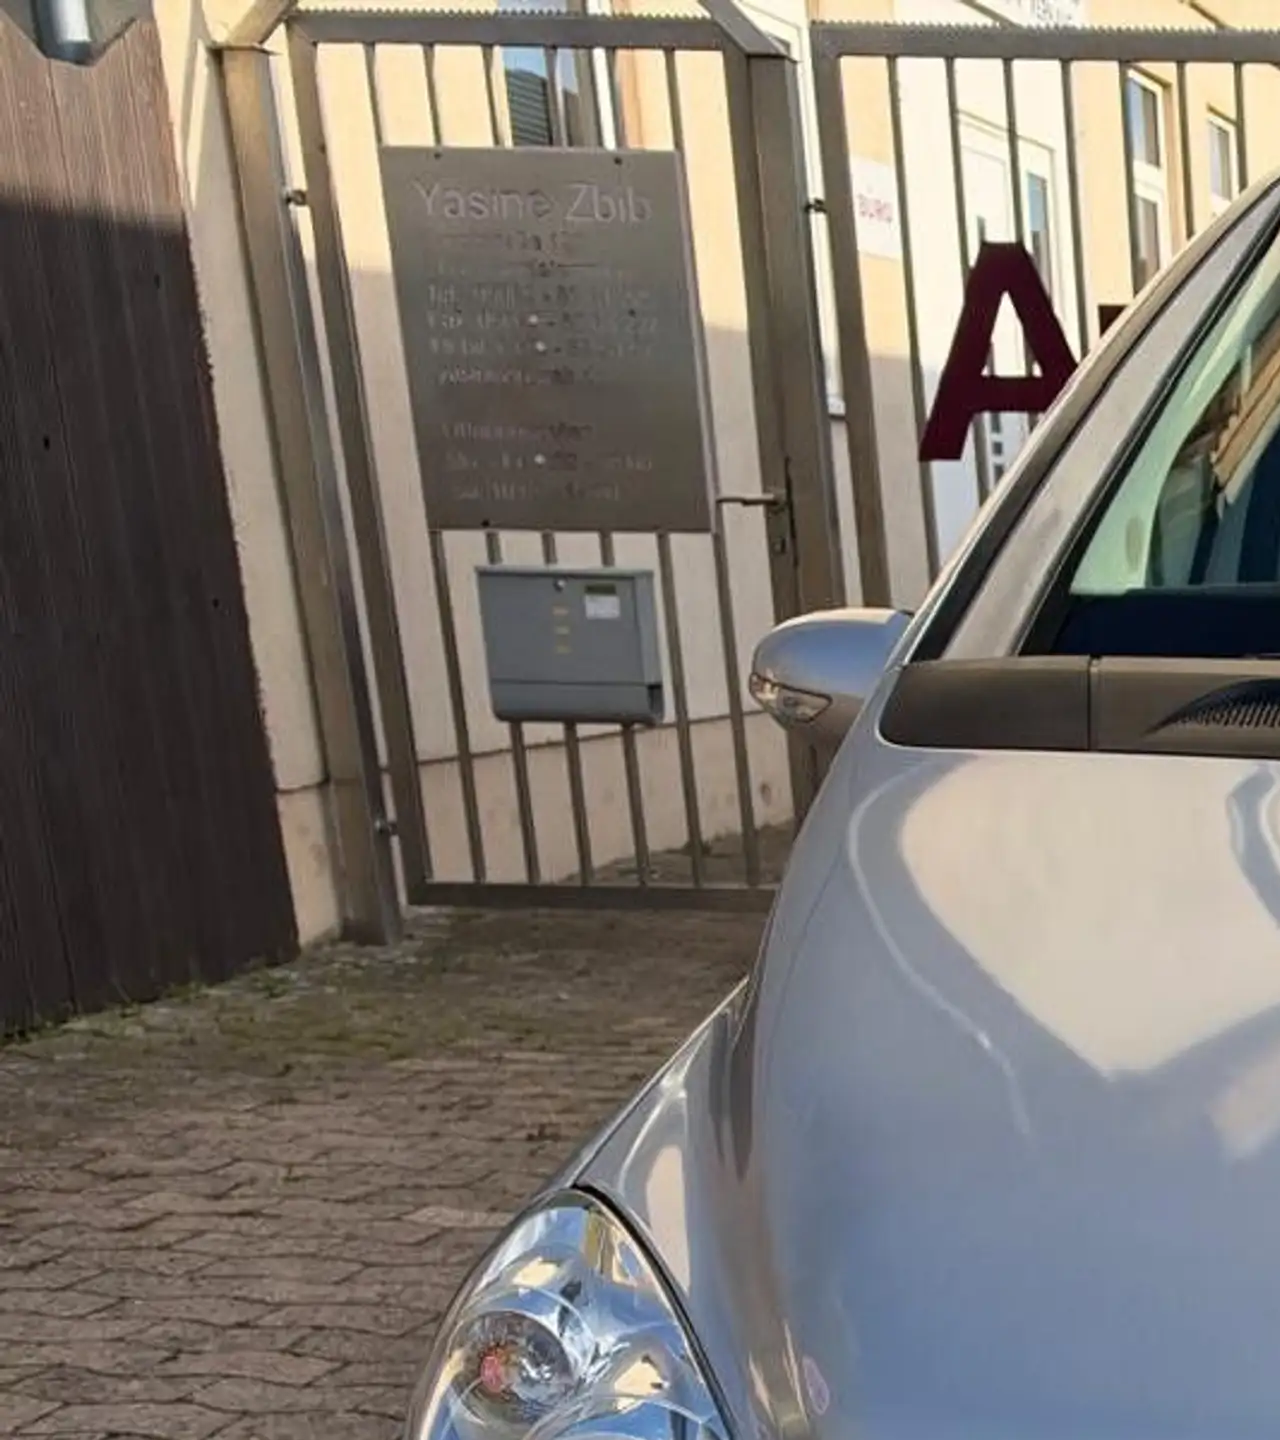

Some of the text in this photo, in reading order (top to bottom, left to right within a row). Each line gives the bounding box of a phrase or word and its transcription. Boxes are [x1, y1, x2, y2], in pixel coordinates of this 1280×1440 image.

[411, 177, 653, 223] Yasine Zbib
[918, 241, 1129, 461] A
